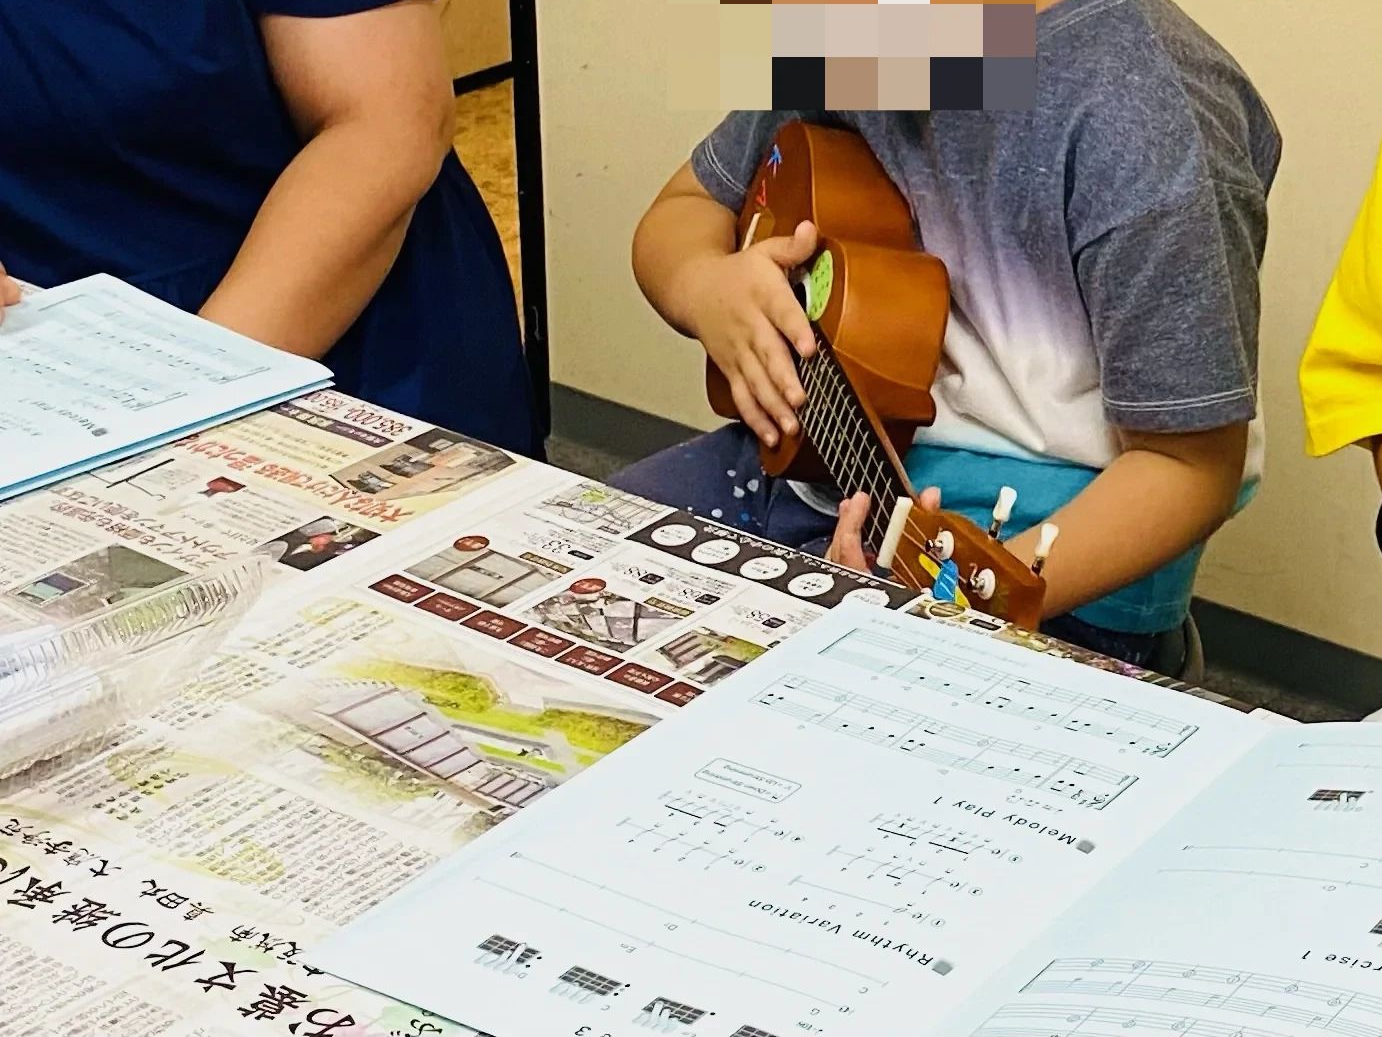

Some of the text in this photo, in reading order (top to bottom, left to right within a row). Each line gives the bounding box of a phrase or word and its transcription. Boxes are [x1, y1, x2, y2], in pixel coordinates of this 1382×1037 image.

[952, 799, 993, 820] Play
[1003, 814, 1077, 845] Melody
[139, 879, 214, 921] 真田丸
[748, 898, 934, 967] Rhythm Variation
